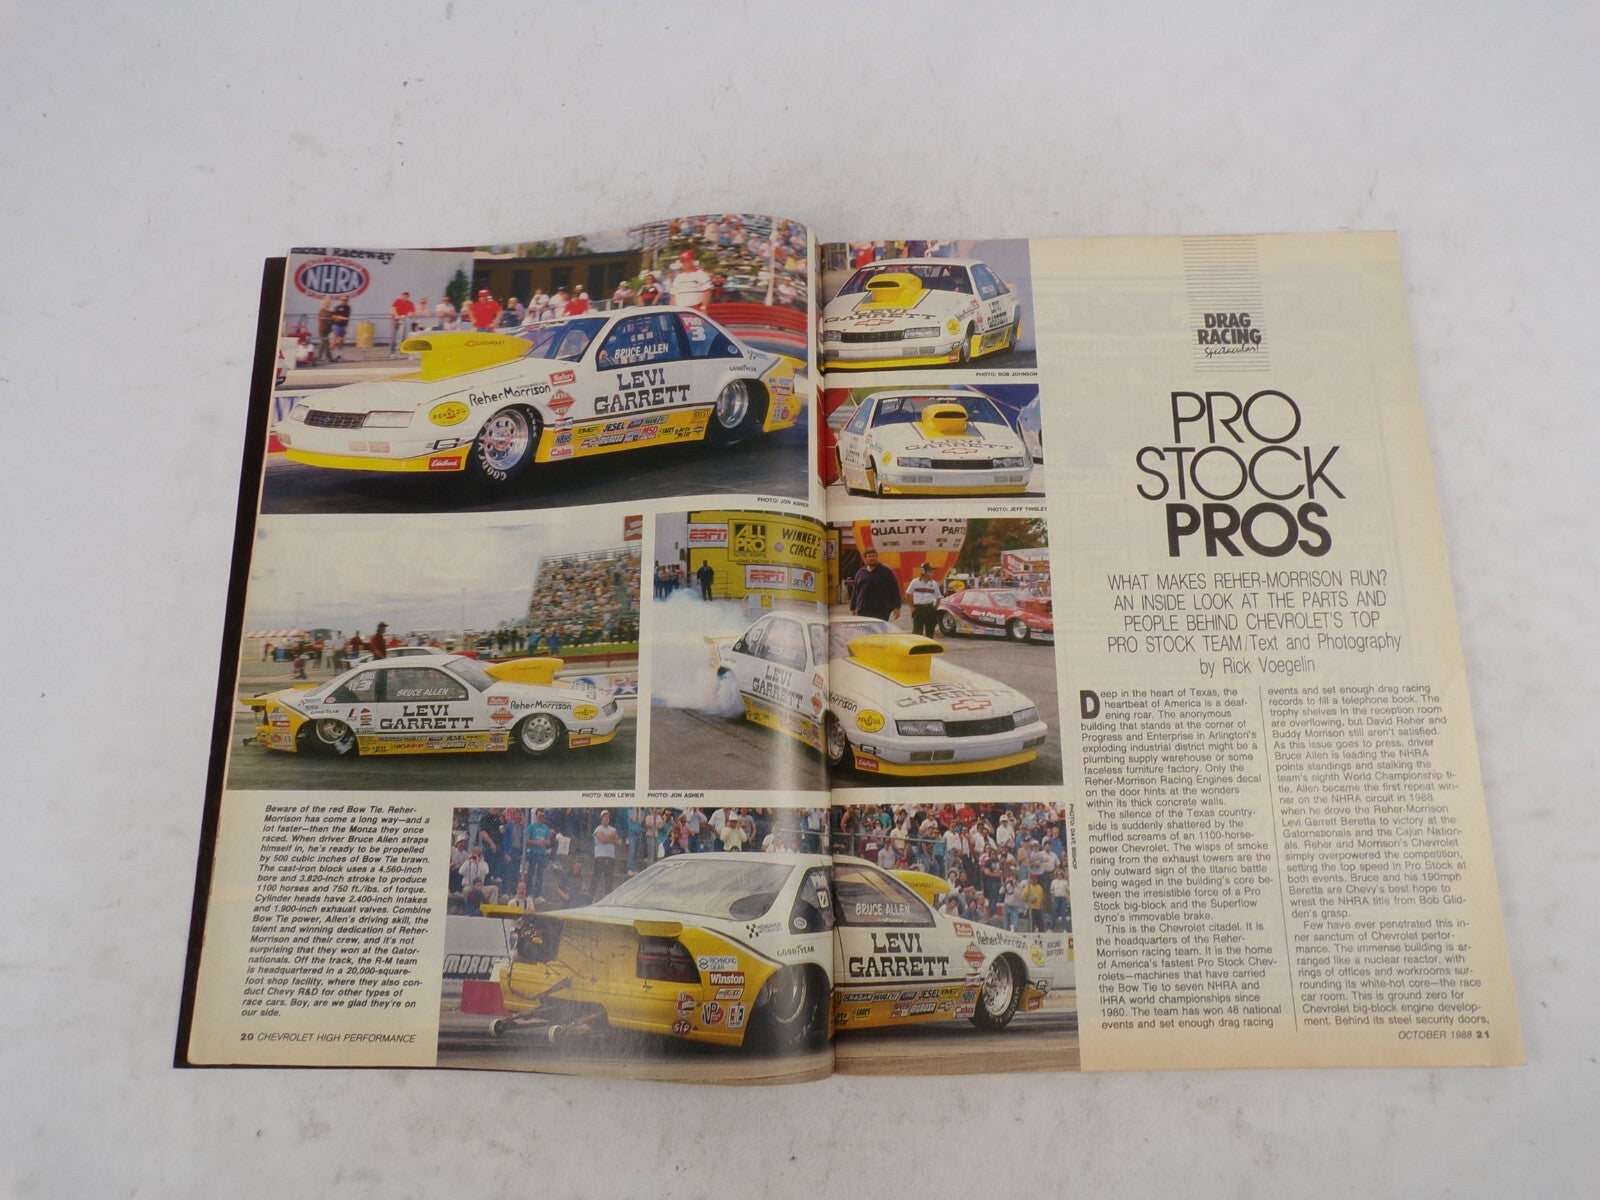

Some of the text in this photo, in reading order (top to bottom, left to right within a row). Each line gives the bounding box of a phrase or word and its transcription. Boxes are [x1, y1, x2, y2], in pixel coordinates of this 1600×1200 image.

[305, 264, 361, 293] NHRA
[1204, 313, 1251, 329] DRAG
[690, 326, 707, 341] 3
[1197, 328, 1261, 346] RACING
[615, 343, 669, 359] BRUCE ALLEN
[616, 368, 665, 391] LEVI
[594, 384, 691, 415] GARRETT
[1170, 390, 1302, 444] PRO
[602, 421, 625, 433] JESEL
[1136, 446, 1346, 500] STOCK
[735, 523, 766, 539] ALL
[871, 525, 927, 536] QUALITY
[1166, 502, 1332, 557] PROS
[735, 538, 766, 552] PRO
[789, 543, 817, 559] CIRCLE
[1107, 570, 1387, 590] WHAT MAKES REHER-MORRISON RUN?
[1114, 590, 1386, 611] AN INSIDE LOOK AT THE PARTS AND
[1124, 610, 1379, 631] PEOPLE BEHIND CHEVROLET'S TOP
[1107, 635, 1138, 653] PRO
[1145, 635, 1194, 652] STOCK
[1286, 633, 1310, 650] and
[1318, 632, 1401, 651] Photography
[1199, 656, 1315, 676] by Rick Voegelin
[764, 664, 793, 687] LEVI
[396, 687, 449, 697] BRUCE ALLEN
[752, 677, 804, 710] GARRETT
[1121, 689, 1129, 697] in
[1132, 689, 1147, 697] the
[1150, 689, 1174, 697] heart
[1177, 688, 1186, 697] of
[1189, 688, 1220, 697] Texas,
[1223, 688, 1237, 696] the
[1267, 683, 1430, 695] events and set enough drag racing
[402, 704, 450, 717] LEVI
[380, 717, 474, 730] GARRETT
[265, 804, 297, 812] Beware
[328, 805, 344, 813] red
[346, 805, 366, 813] Bow
[370, 805, 384, 813] Tie.
[387, 805, 416, 813] Reher-
[264, 814, 302, 822] Morrison
[304, 814, 320, 822] has
[358, 815, 378, 825] long
[856, 903, 911, 916] BRUCE ALLEN
[870, 932, 923, 954] LEVI
[777, 945, 816, 958] GOODYEAR
[849, 956, 949, 978] GARRETT
[710, 973, 745, 985] Winston
[920, 989, 940, 999] JESEL
[1304, 1014, 1489, 1025] ment. Behind its steel security doors,
[240, 1032, 416, 1043] 20 CHEVROLET HIGH PERFORMANCE
[1398, 1030, 1489, 1039] OCTOBER 1988 21
